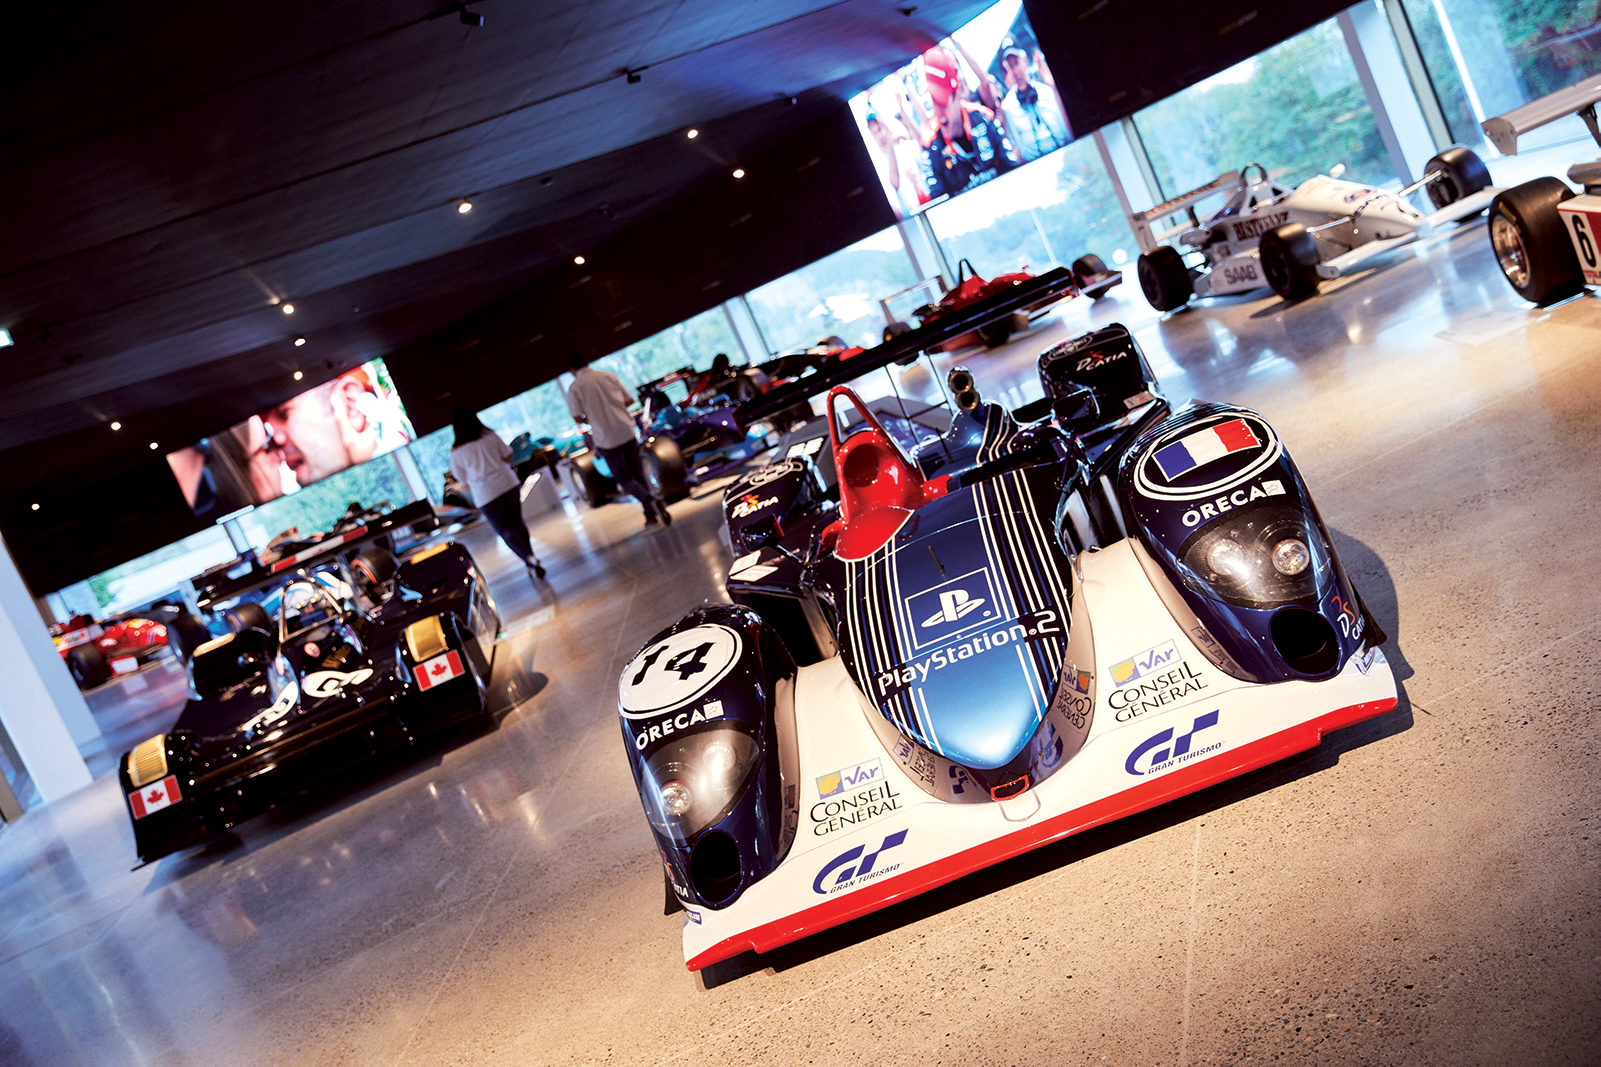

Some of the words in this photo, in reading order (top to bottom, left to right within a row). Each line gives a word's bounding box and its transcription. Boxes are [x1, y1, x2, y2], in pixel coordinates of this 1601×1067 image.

[1572, 215, 1597, 267] 6
[1224, 265, 1258, 285] SAAB
[1085, 351, 1127, 371] CATIA
[1181, 486, 1266, 528] ORECA
[631, 641, 716, 687] 14
[635, 713, 706, 751] ORECA
[1147, 760, 1175, 774] GRAN
[1177, 742, 1222, 763] TURISMO
[830, 879, 856, 894] GRAN
[858, 863, 900, 884] TURISMO
